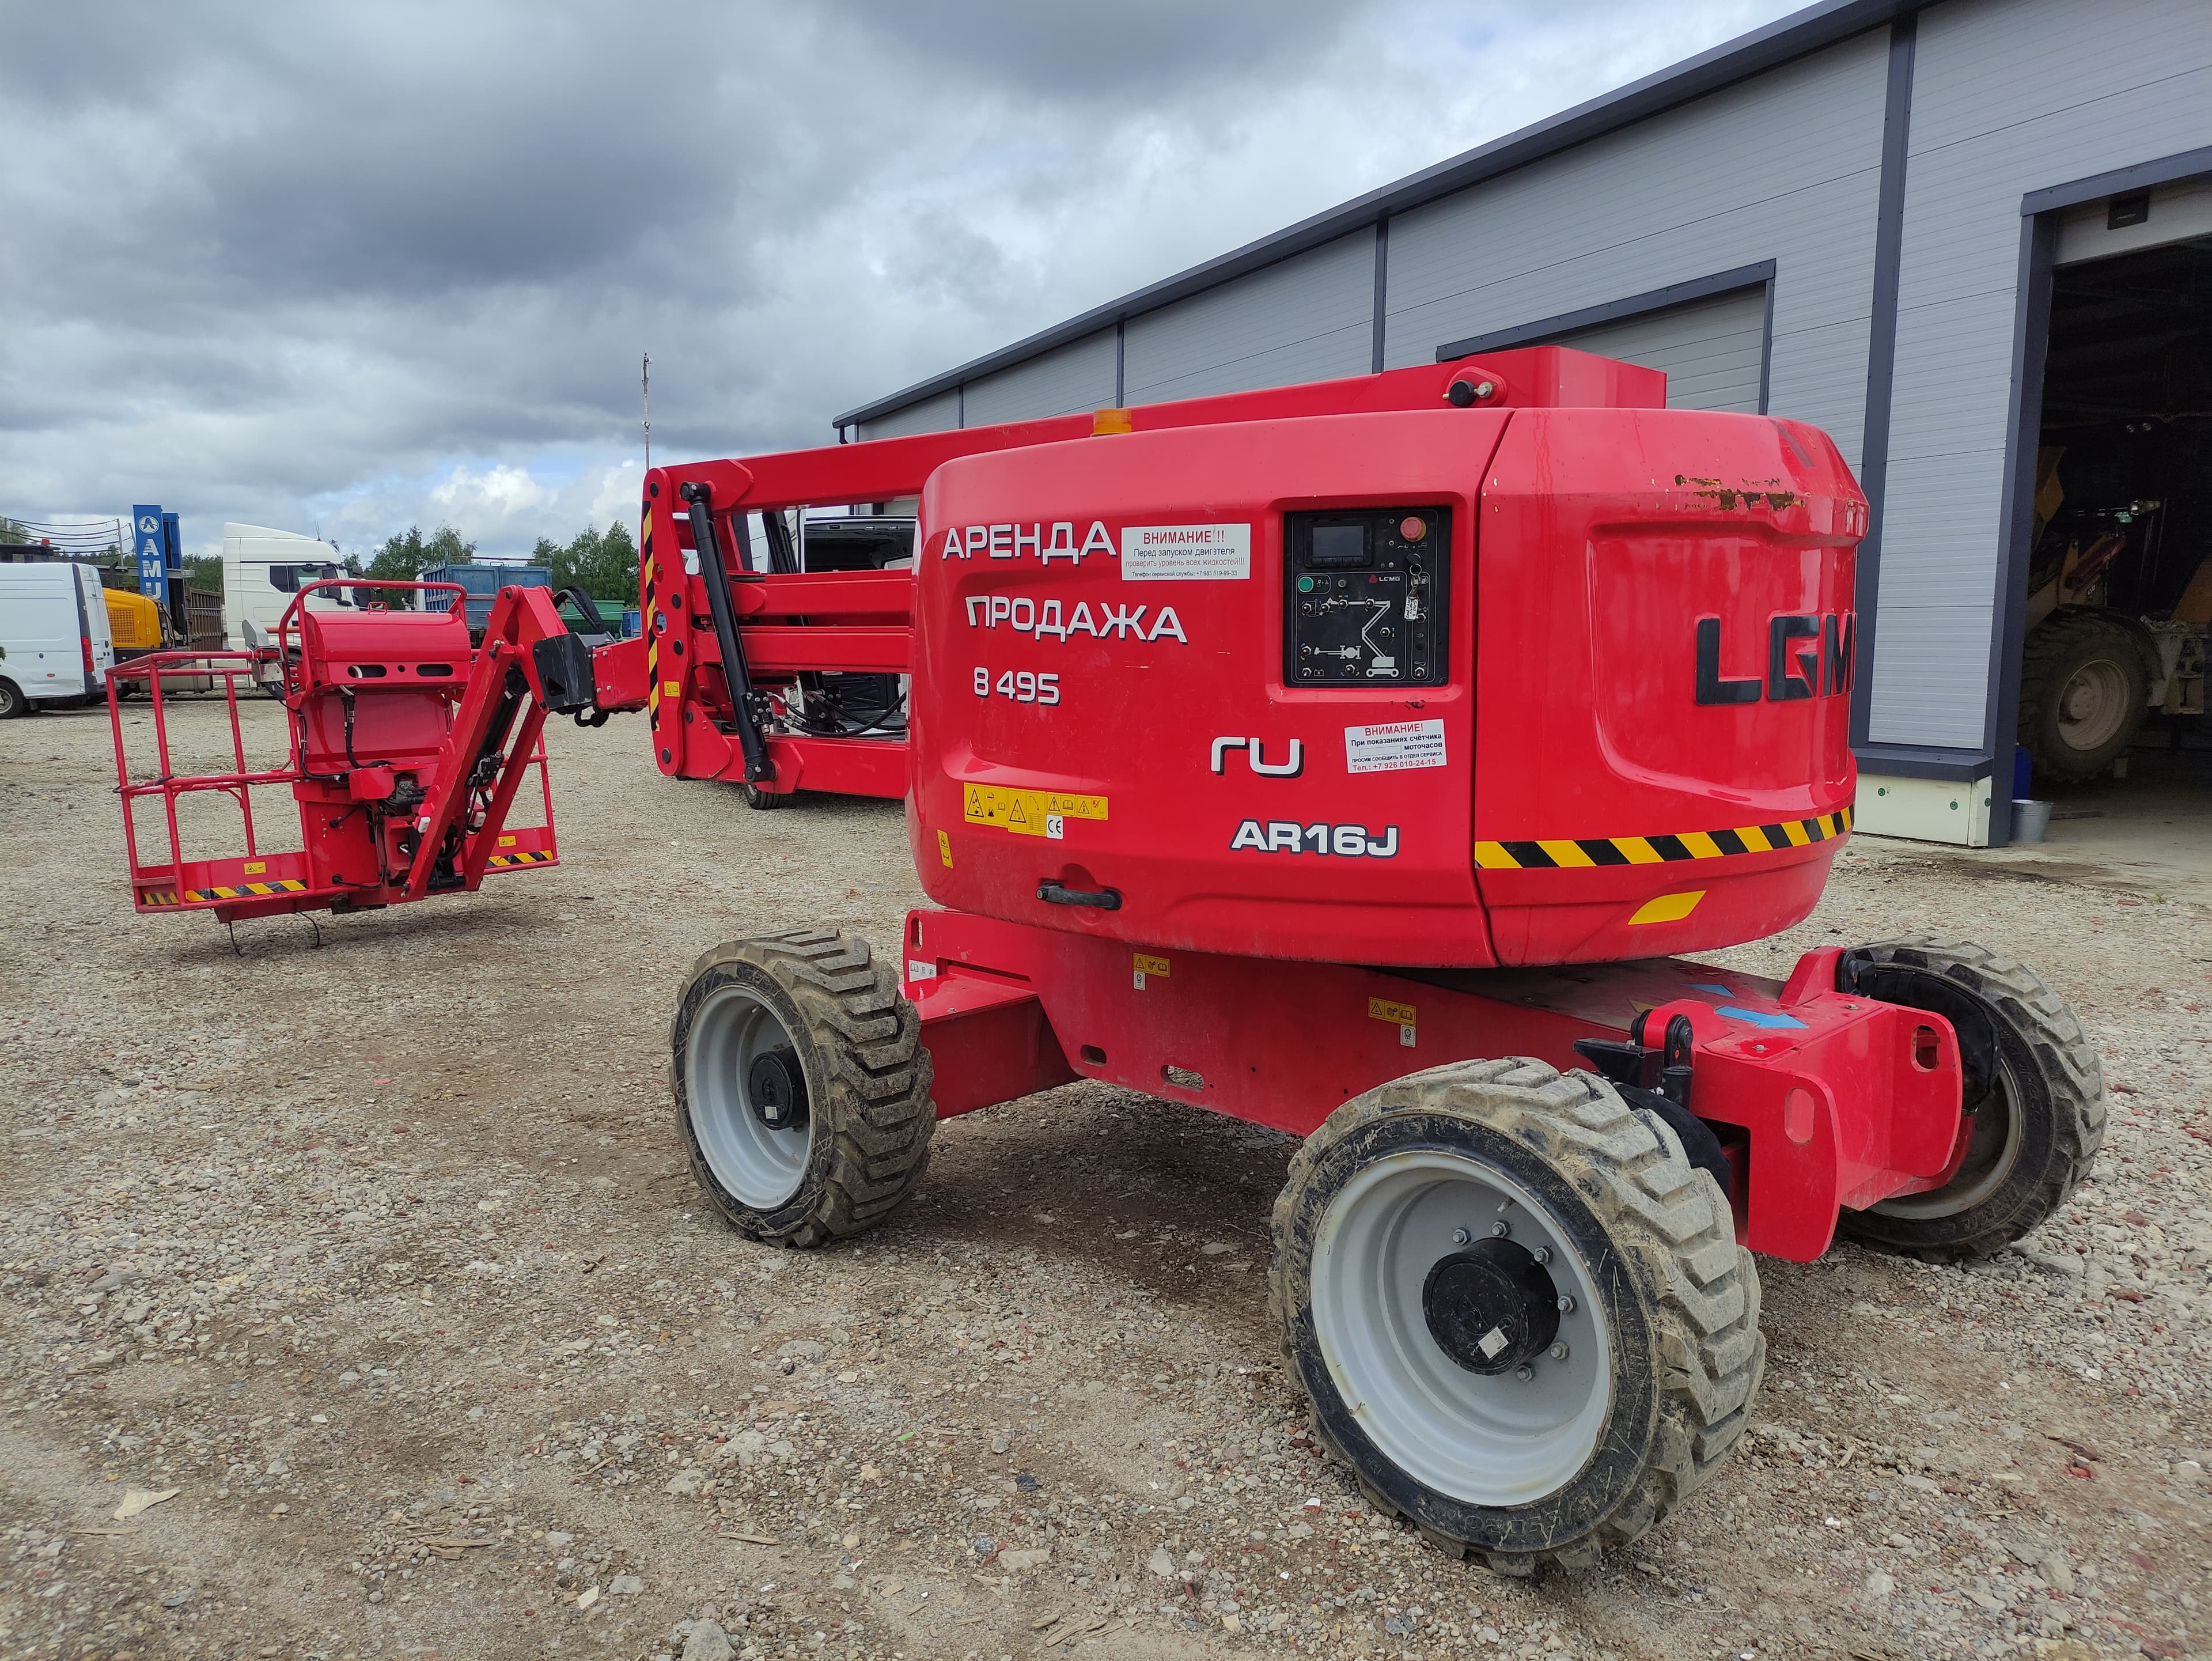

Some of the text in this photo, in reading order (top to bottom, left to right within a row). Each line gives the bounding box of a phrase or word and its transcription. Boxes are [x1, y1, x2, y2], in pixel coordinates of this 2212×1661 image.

[941, 520, 1118, 565] АРЕНДА
[1134, 548, 1157, 558] Перед
[1158, 548, 1193, 558] запуском
[1126, 560, 1157, 569] проверить
[1158, 559, 1184, 568] уровень
[965, 595, 1188, 644] ПРОДАЖА
[974, 667, 1060, 705] 8 495
[1365, 722, 1424, 736] ВНИМАНИЕ!
[1351, 733, 1442, 748] При показаниях счётчика
[1404, 742, 1443, 750] моточасов
[1384, 761, 1397, 769] 926
[1400, 758, 1437, 767] 010-24-15
[1230, 820, 1399, 857] AR16J
